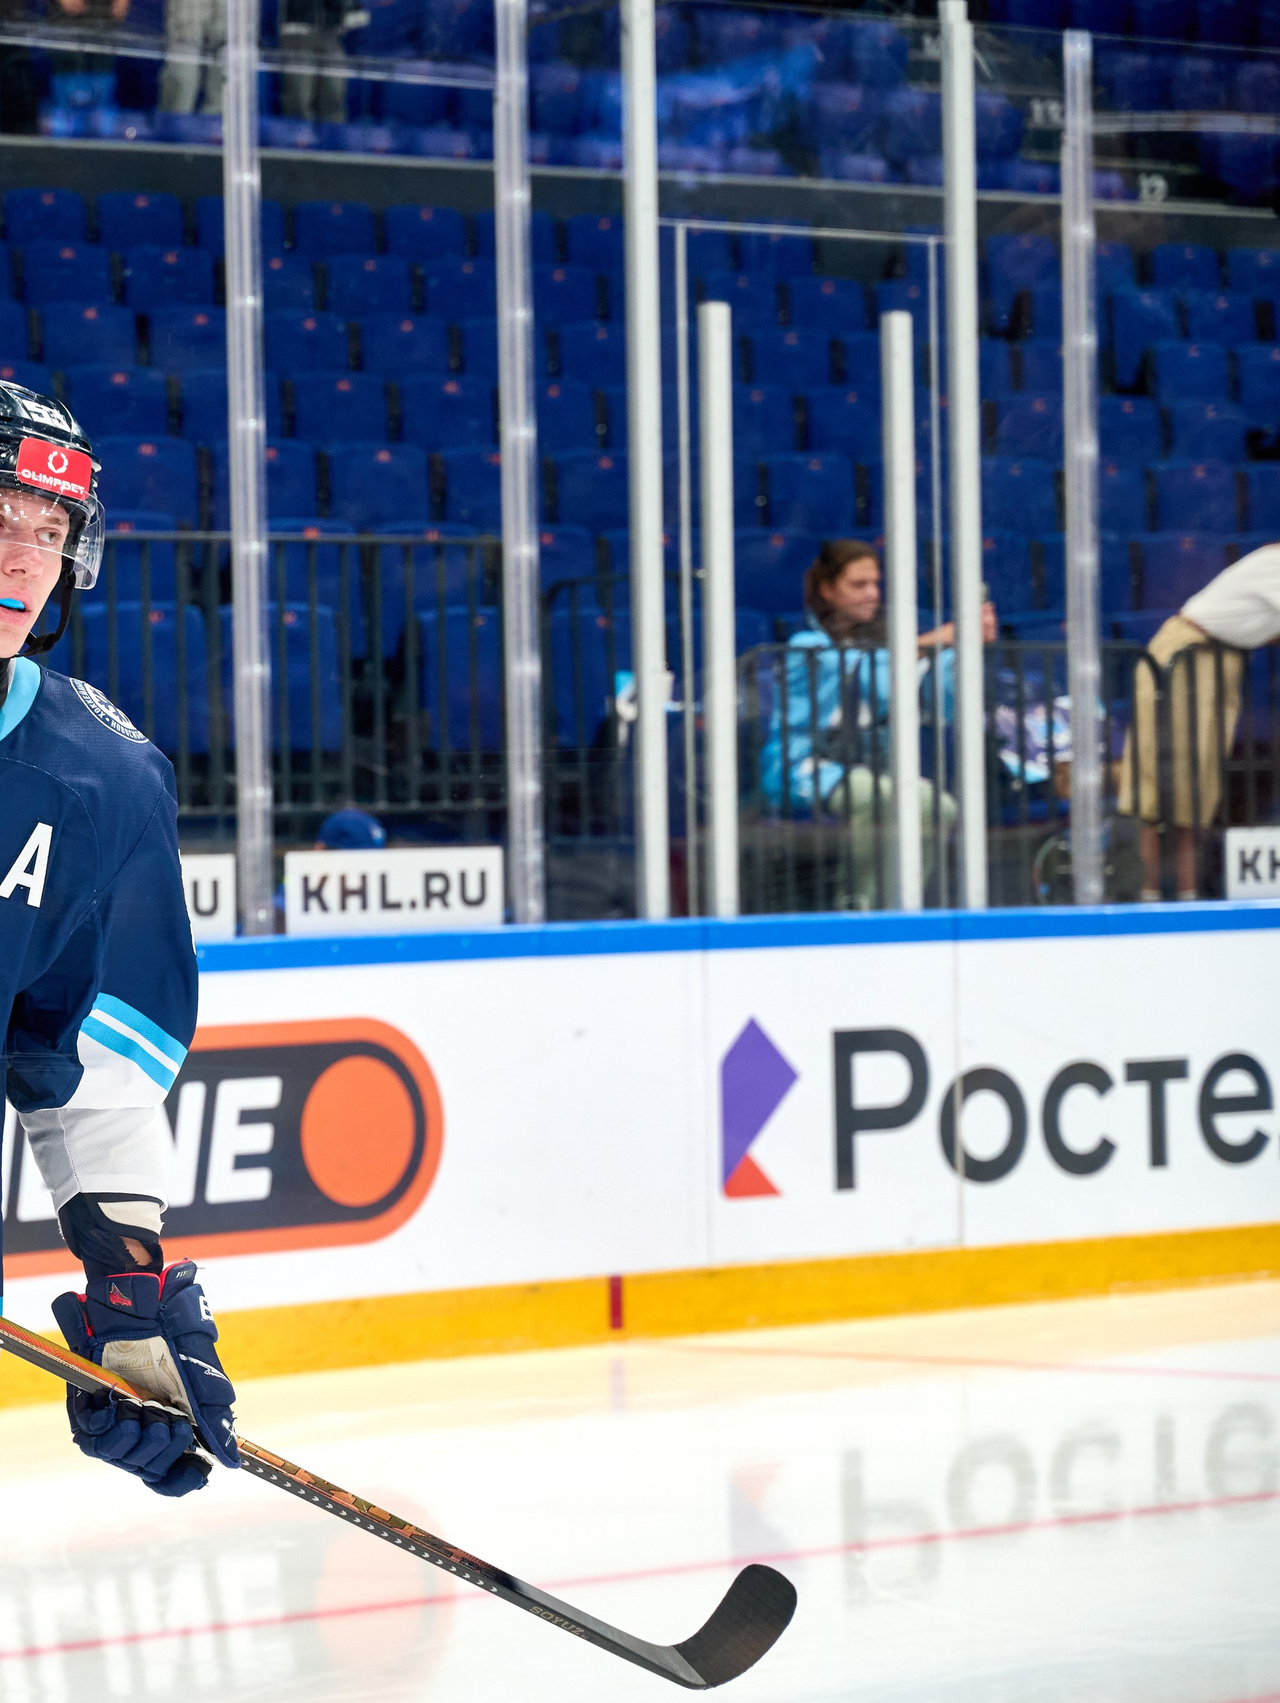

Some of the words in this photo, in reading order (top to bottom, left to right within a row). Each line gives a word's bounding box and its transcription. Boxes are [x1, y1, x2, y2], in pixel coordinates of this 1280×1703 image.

[21, 468, 85, 495] OLIMPBET
[302, 870, 488, 914] KHL.RU
[831, 1024, 1280, 1193] Росте
[529, 1605, 585, 1635] SOYUZ
